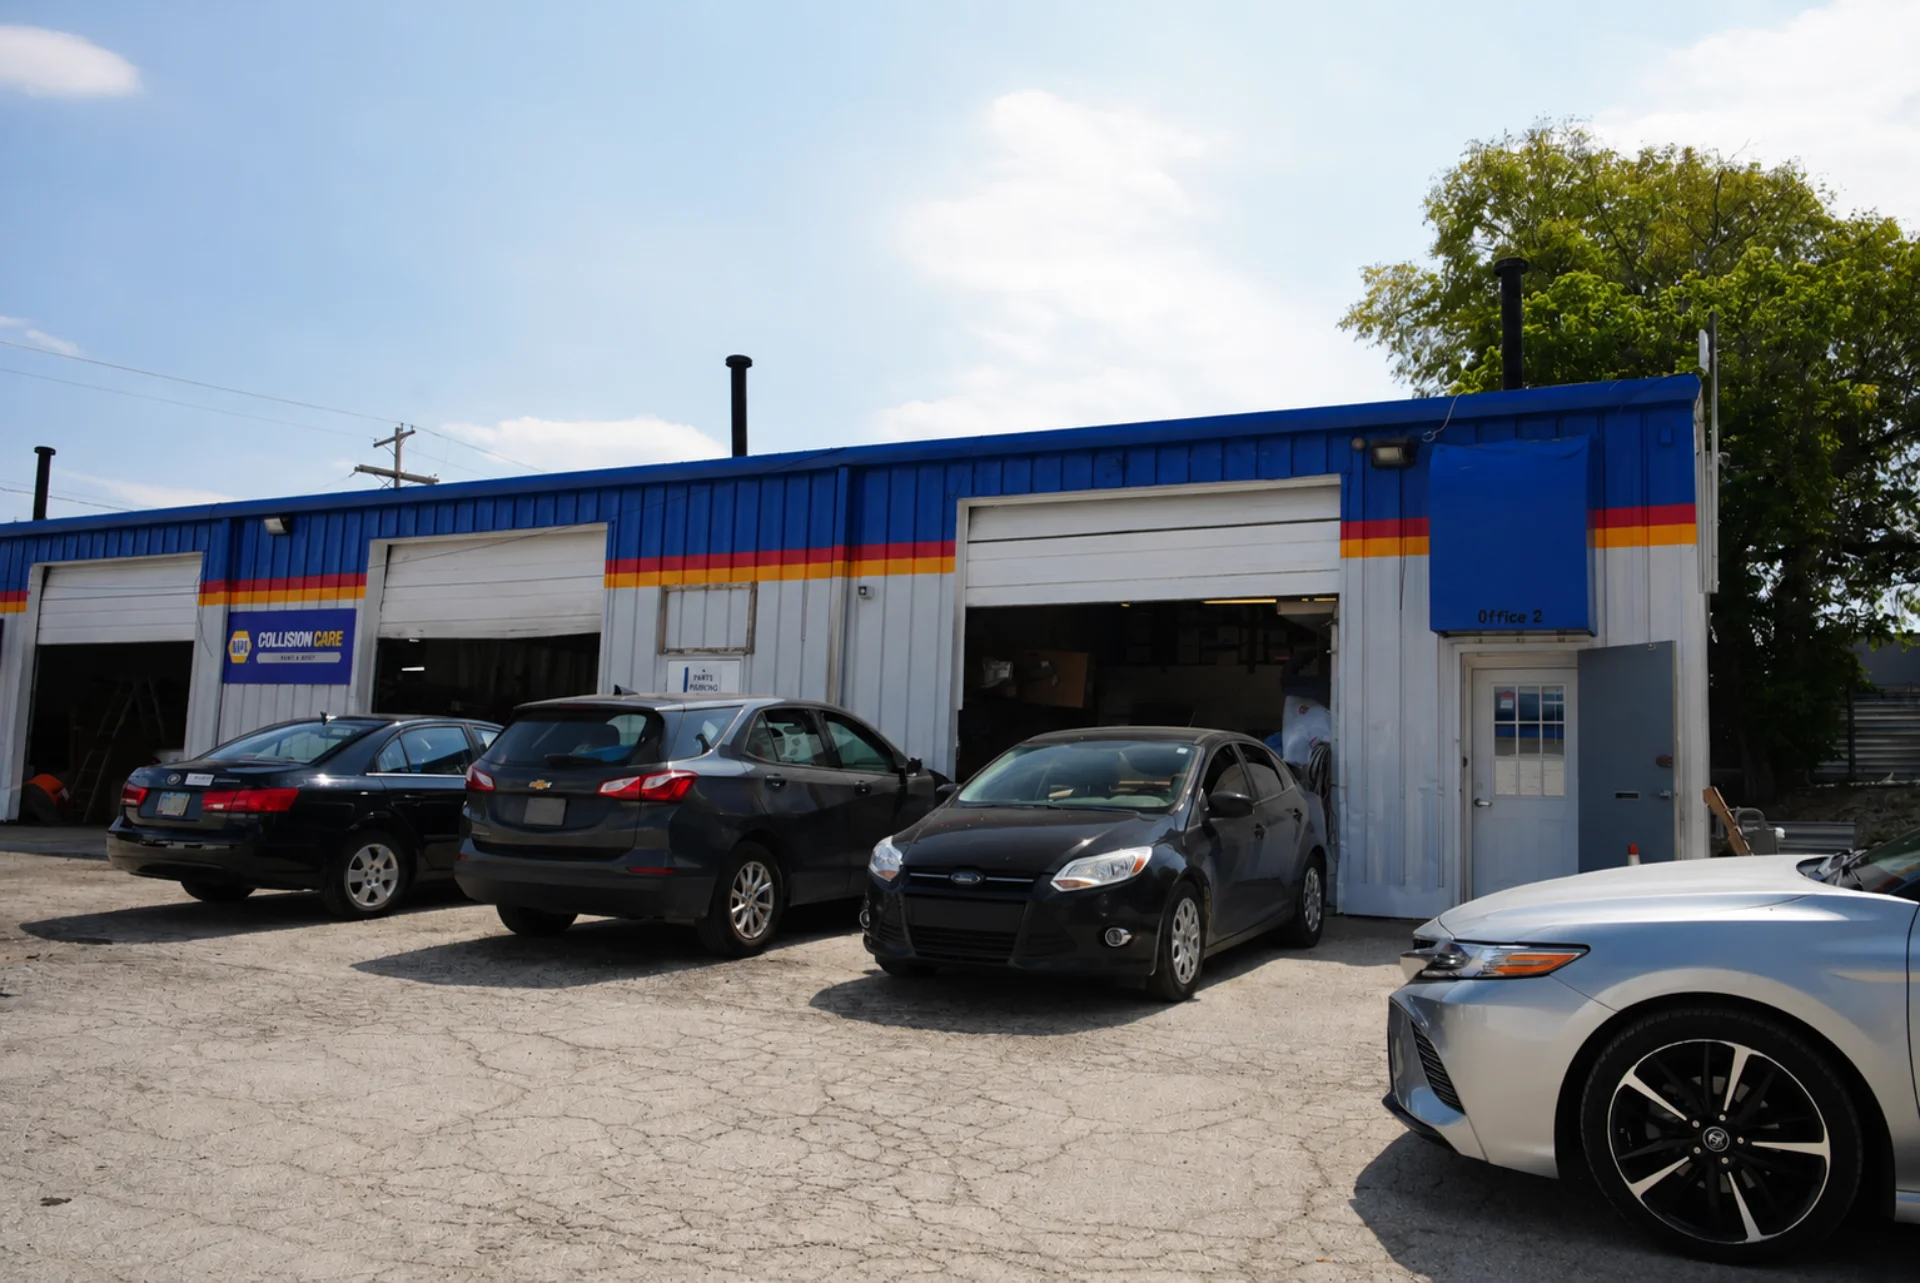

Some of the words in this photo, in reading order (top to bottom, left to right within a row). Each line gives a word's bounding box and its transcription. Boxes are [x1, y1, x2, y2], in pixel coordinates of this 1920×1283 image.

[1478, 609, 1526, 624] Office
[1533, 609, 1543, 623] 2
[258, 631, 313, 648] COLLISION
[313, 631, 344, 647] CARE
